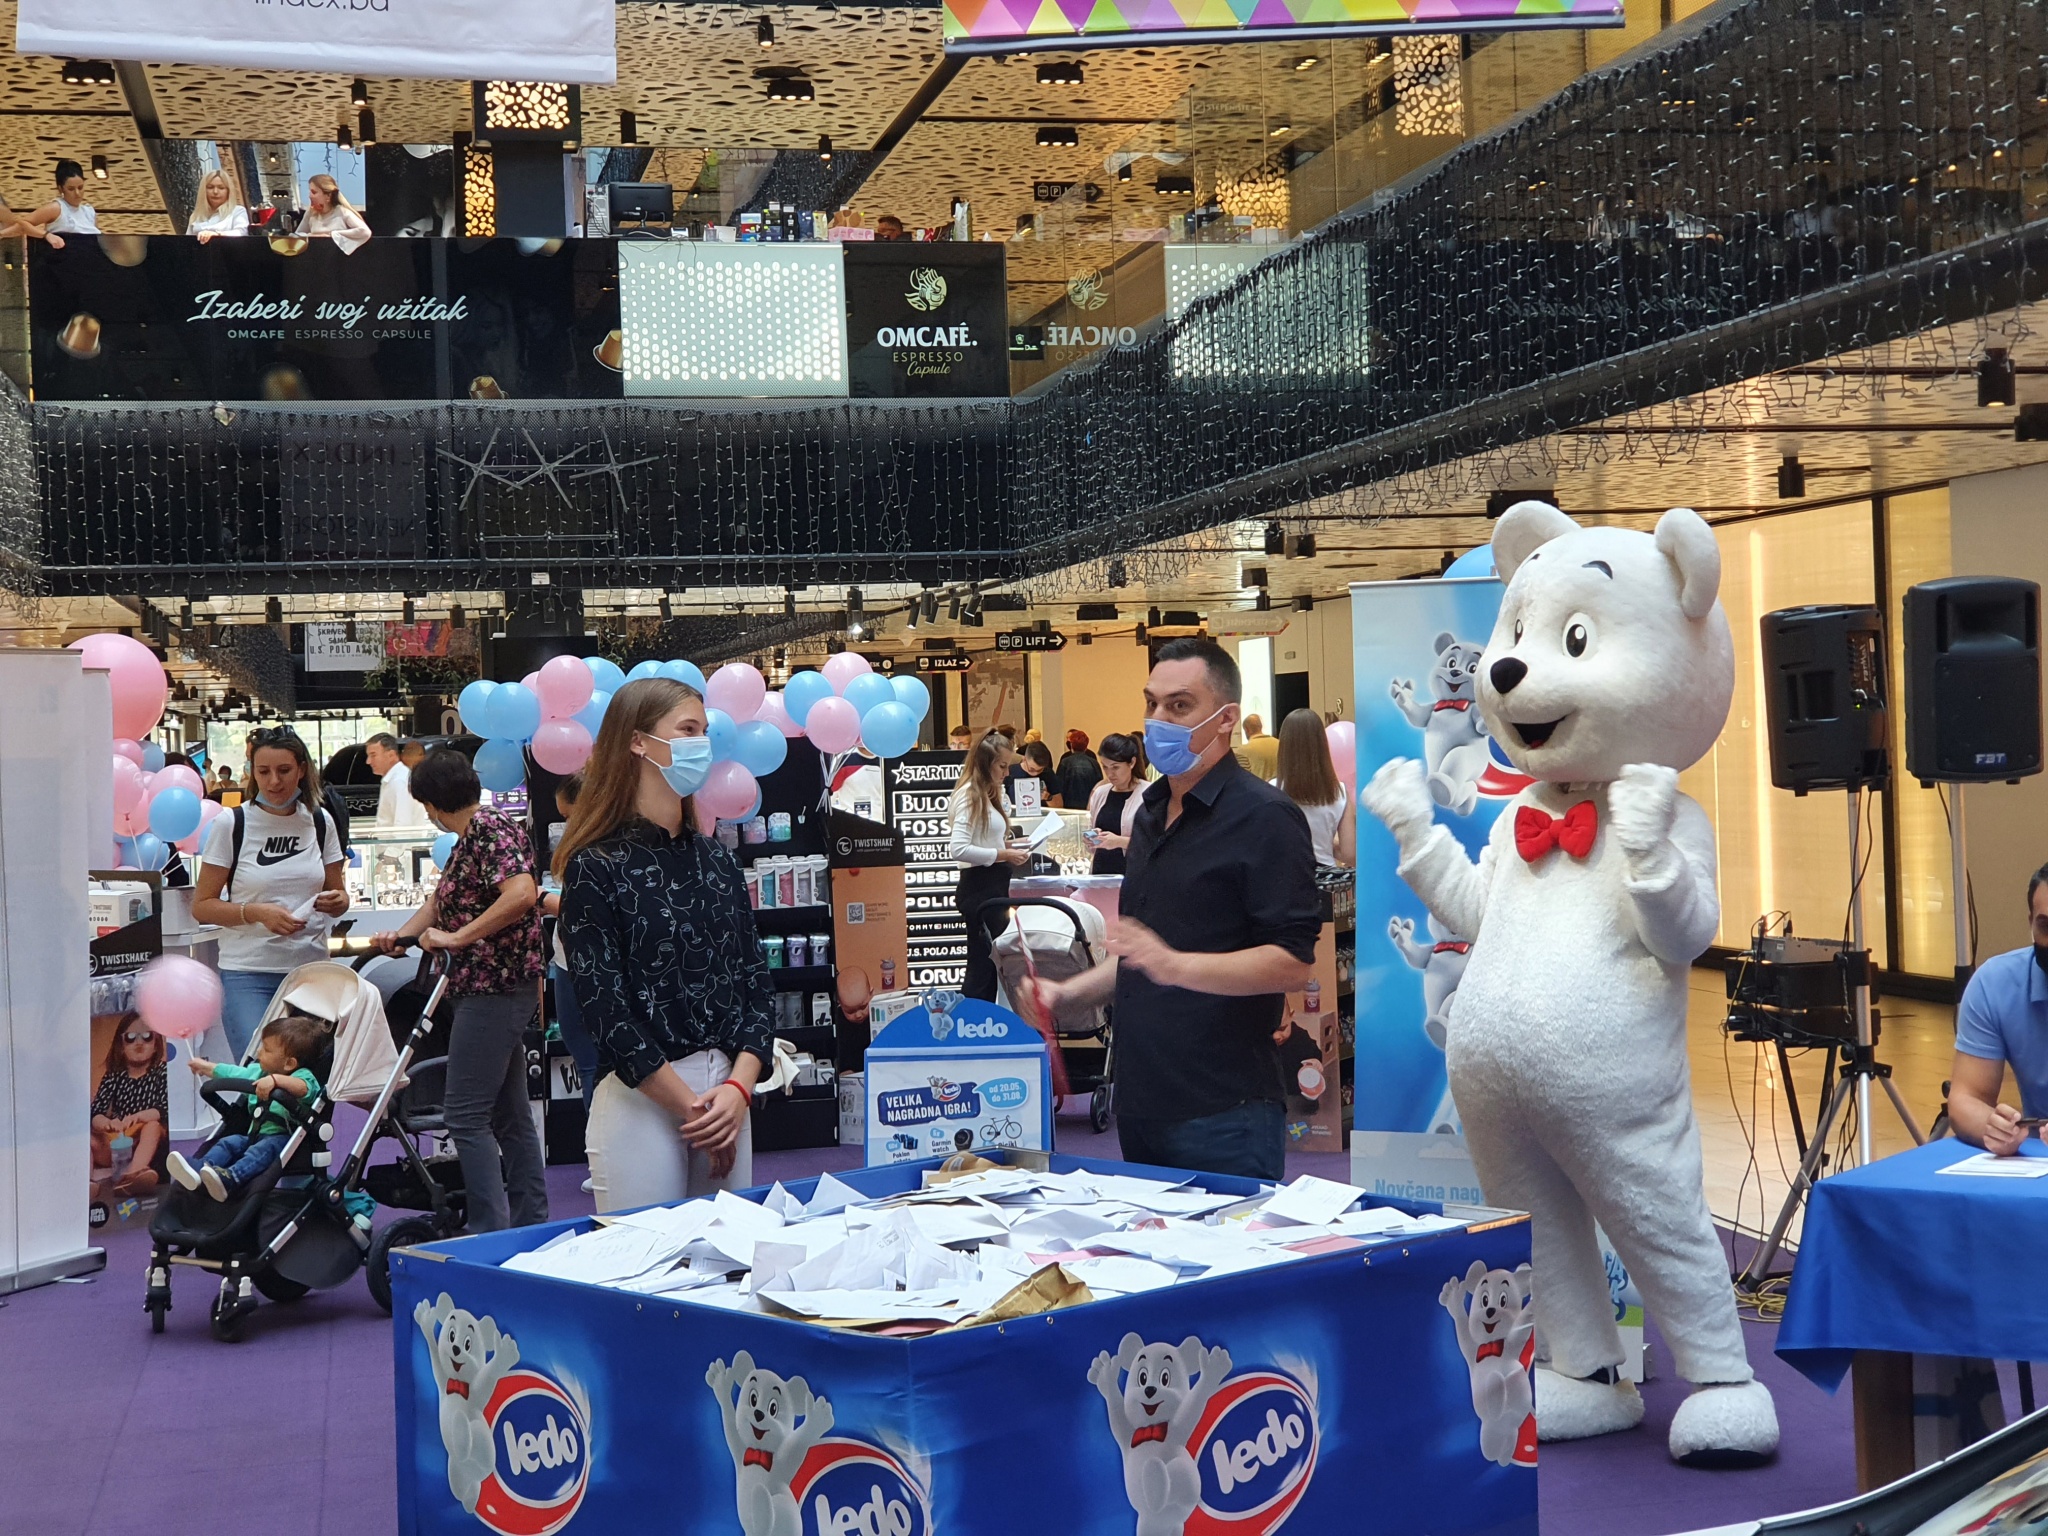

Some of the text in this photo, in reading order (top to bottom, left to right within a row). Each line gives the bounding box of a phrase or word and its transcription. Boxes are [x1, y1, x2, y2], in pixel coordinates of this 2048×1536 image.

[186, 290, 469, 329] Izaberi svoj užitak
[227, 329, 431, 339] OMCAFE ESPRESSO CAPSULE
[893, 351, 963, 362] ESPRESSO
[907, 361, 951, 379] Capsule
[1025, 636, 1047, 646] LIFT
[329, 645, 351, 654] POLO
[934, 658, 957, 667] IZLAZ
[1976, 753, 2006, 764] FBT
[901, 794, 951, 812] BULO
[264, 836, 300, 853] NIKE
[905, 844, 942, 853] BEVERLY
[913, 852, 937, 861] POLO
[923, 947, 948, 956] POLO
[957, 1017, 1008, 1039] ledo
[944, 1085, 959, 1094] ledo
[886, 1094, 922, 1108] VELIKA
[991, 1094, 1001, 1103] do
[887, 1101, 971, 1122] NAGRADNA IGRA!
[932, 1139, 951, 1147] Garmin
[1375, 1178, 1445, 1201] Novčana
[504, 1414, 578, 1476] ledo
[1211, 1408, 1305, 1494] ledo
[815, 1485, 912, 1536] ledo
